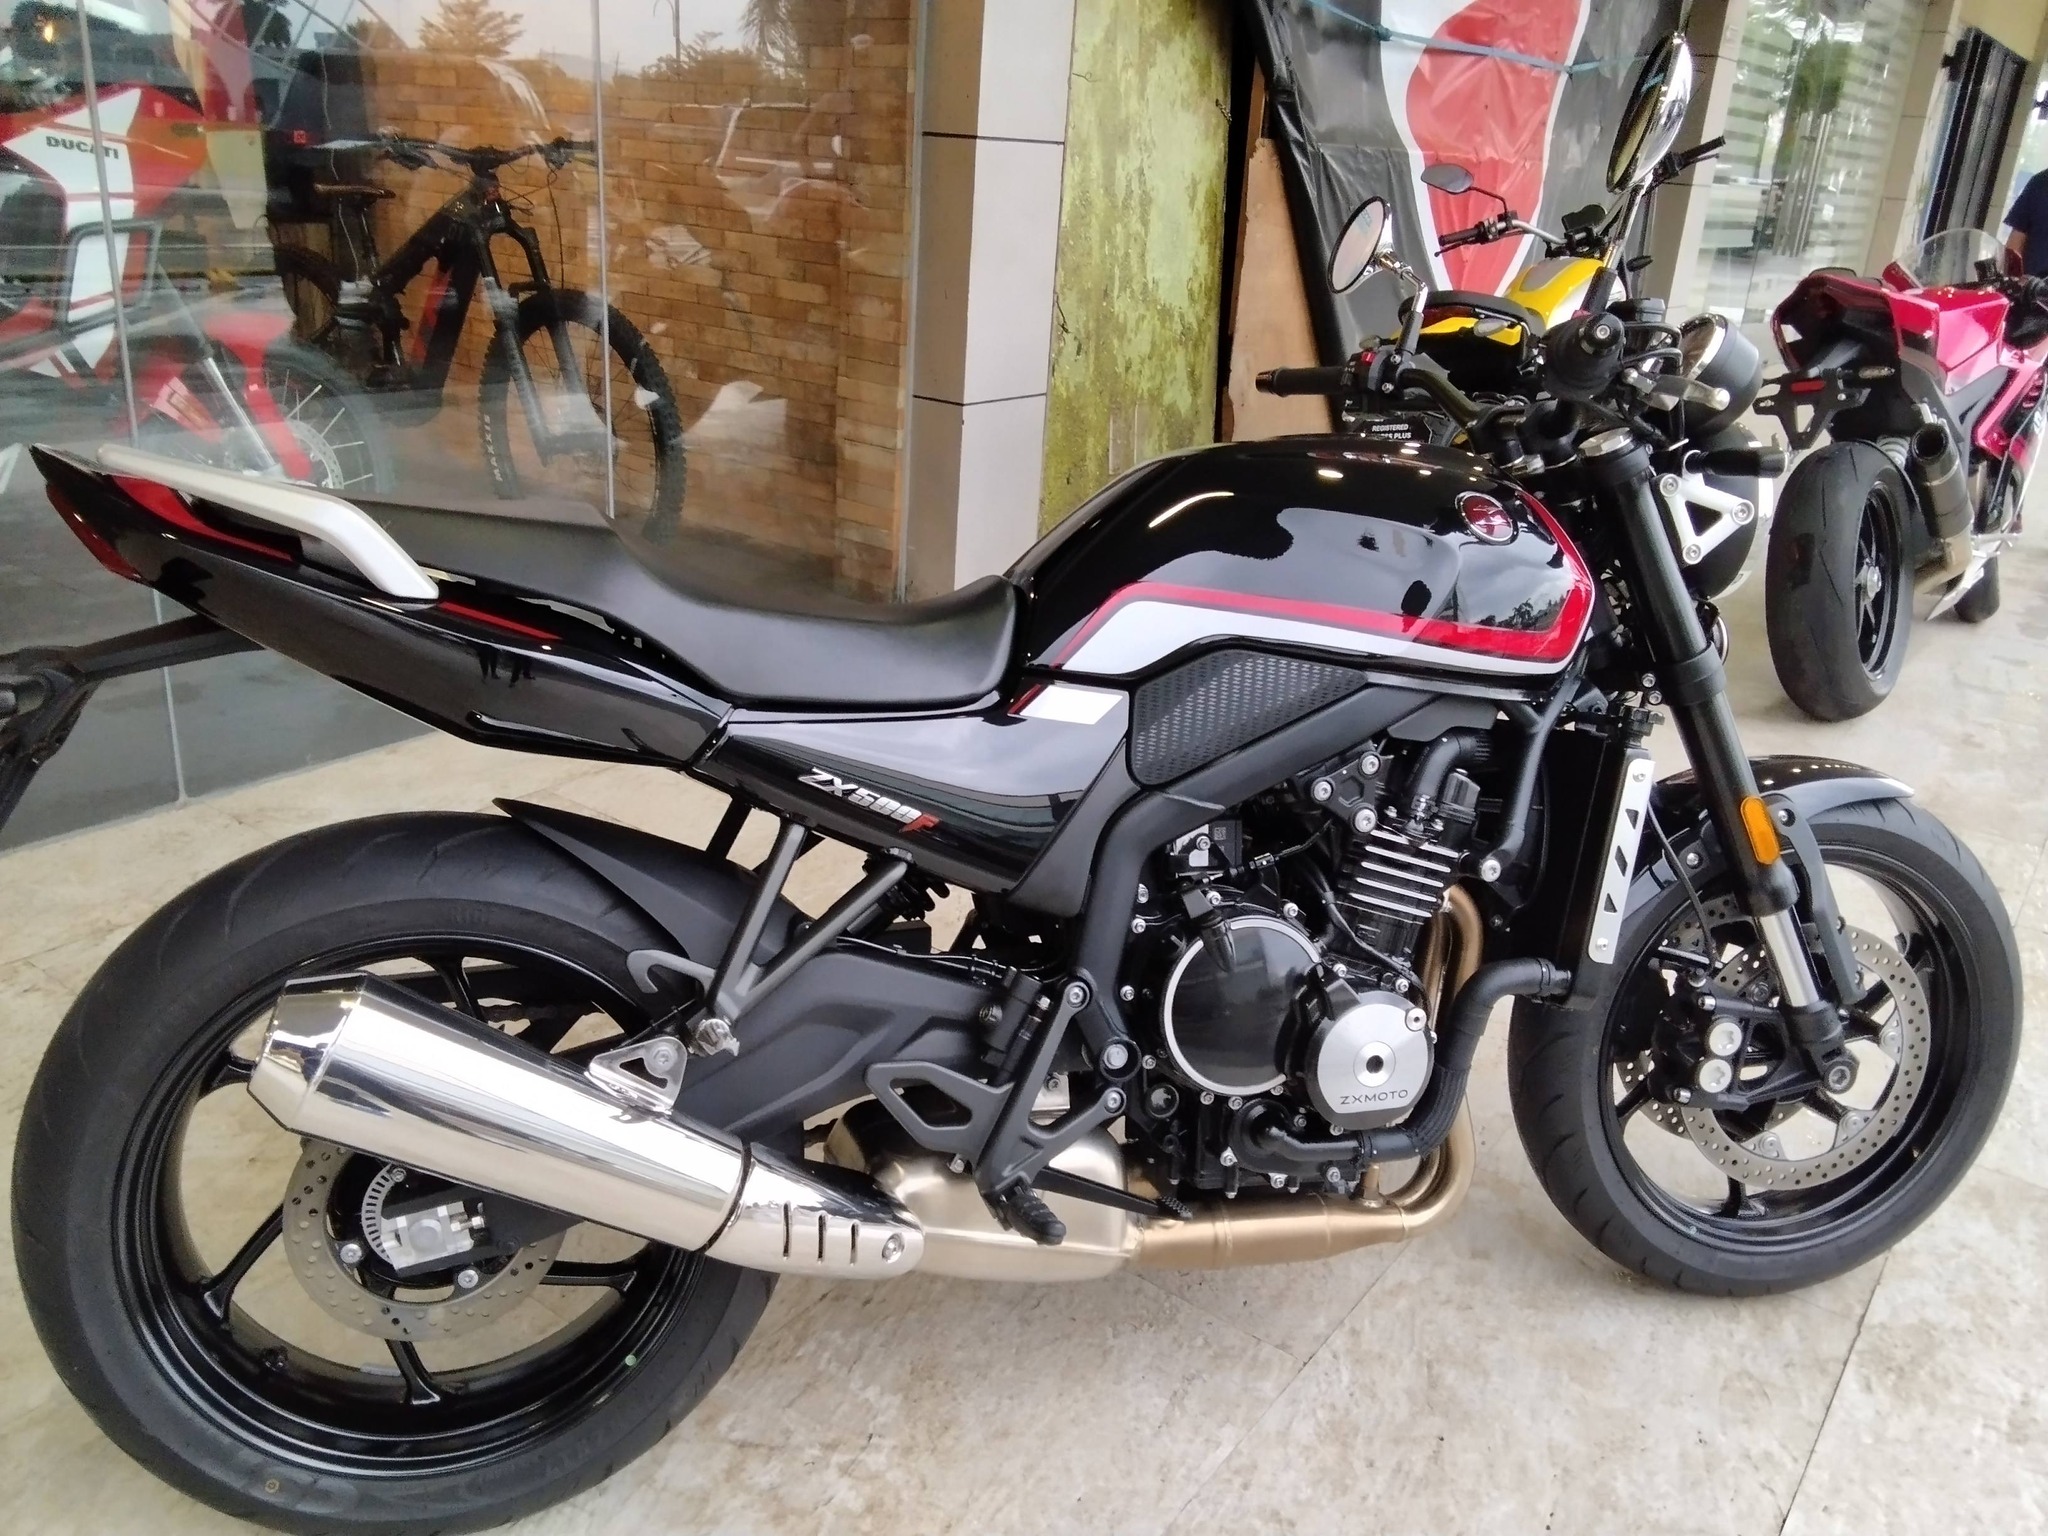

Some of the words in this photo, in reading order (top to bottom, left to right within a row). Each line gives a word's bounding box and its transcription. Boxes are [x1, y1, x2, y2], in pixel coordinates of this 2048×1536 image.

[1371, 423, 1409, 432] REGISTERED
[484, 414, 503, 482] MAXXIS
[1340, 1089, 1409, 1105] ZXMOTO
